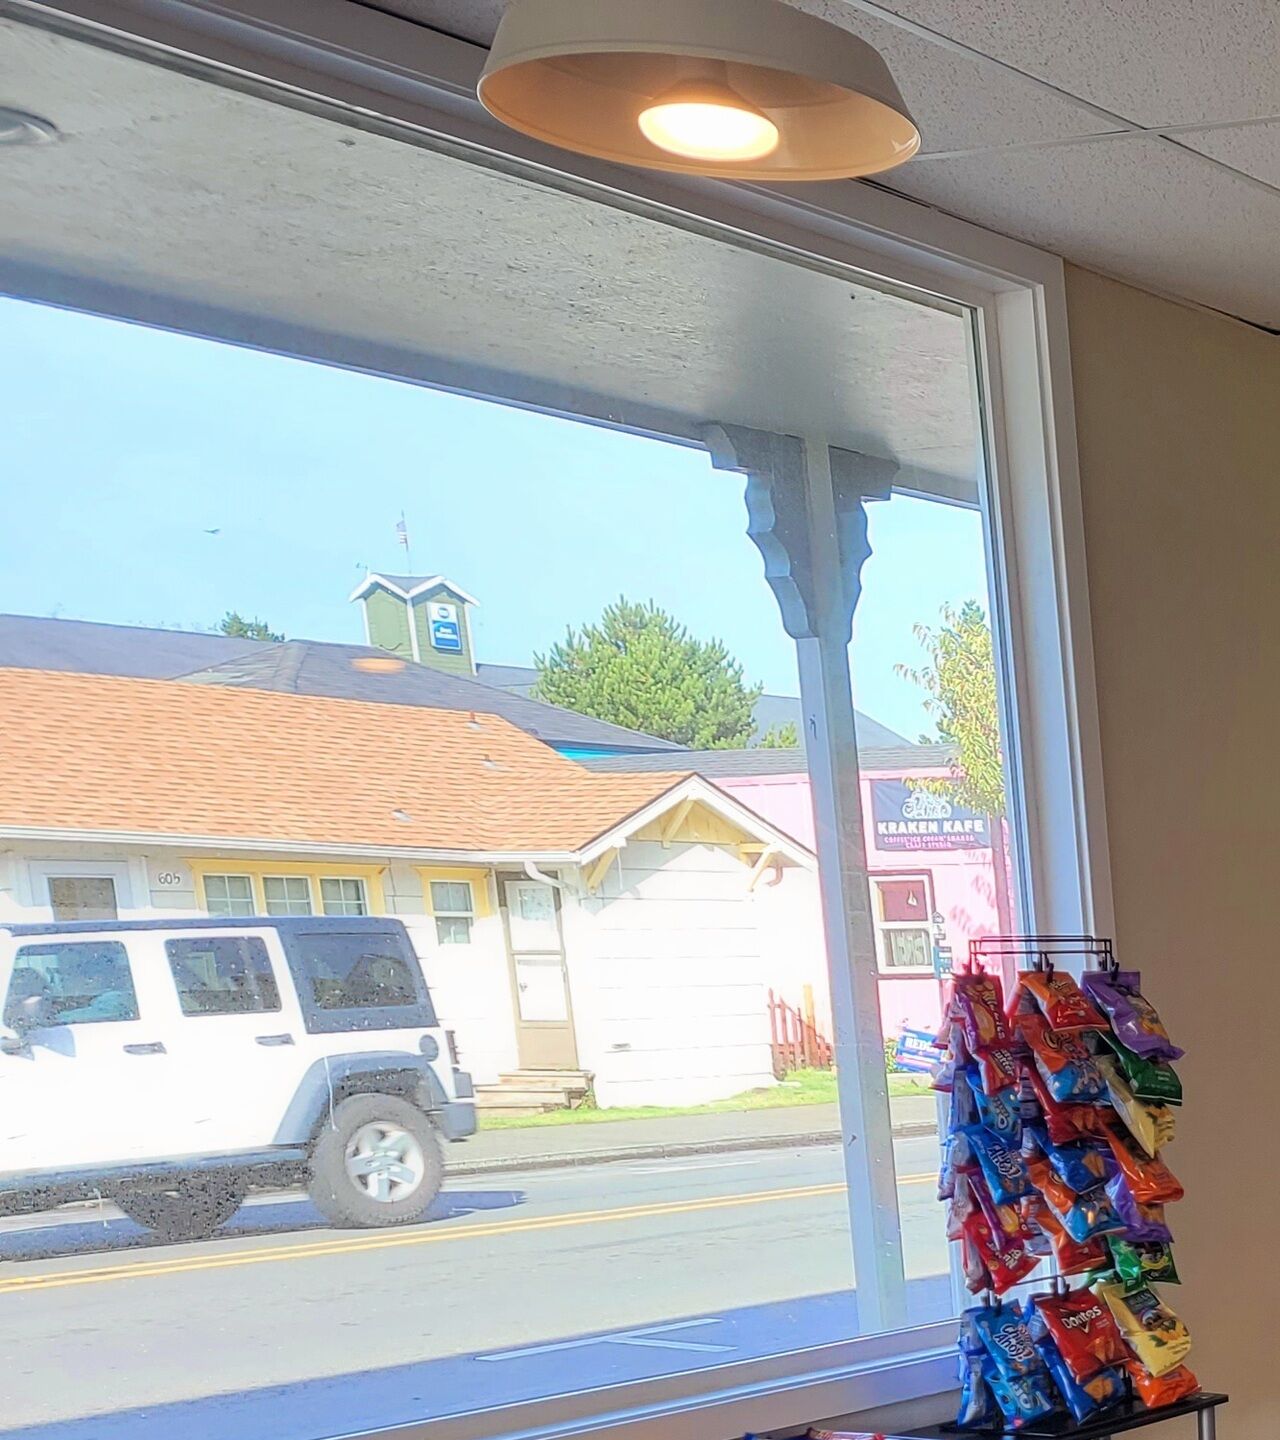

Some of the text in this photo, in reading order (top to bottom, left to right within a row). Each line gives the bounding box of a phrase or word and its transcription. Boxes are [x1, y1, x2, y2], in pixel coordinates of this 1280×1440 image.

[877, 820, 984, 834] KRAKEN KAFE
[159, 873, 180, 884] 605
[1061, 1305, 1102, 1329] Doritos
